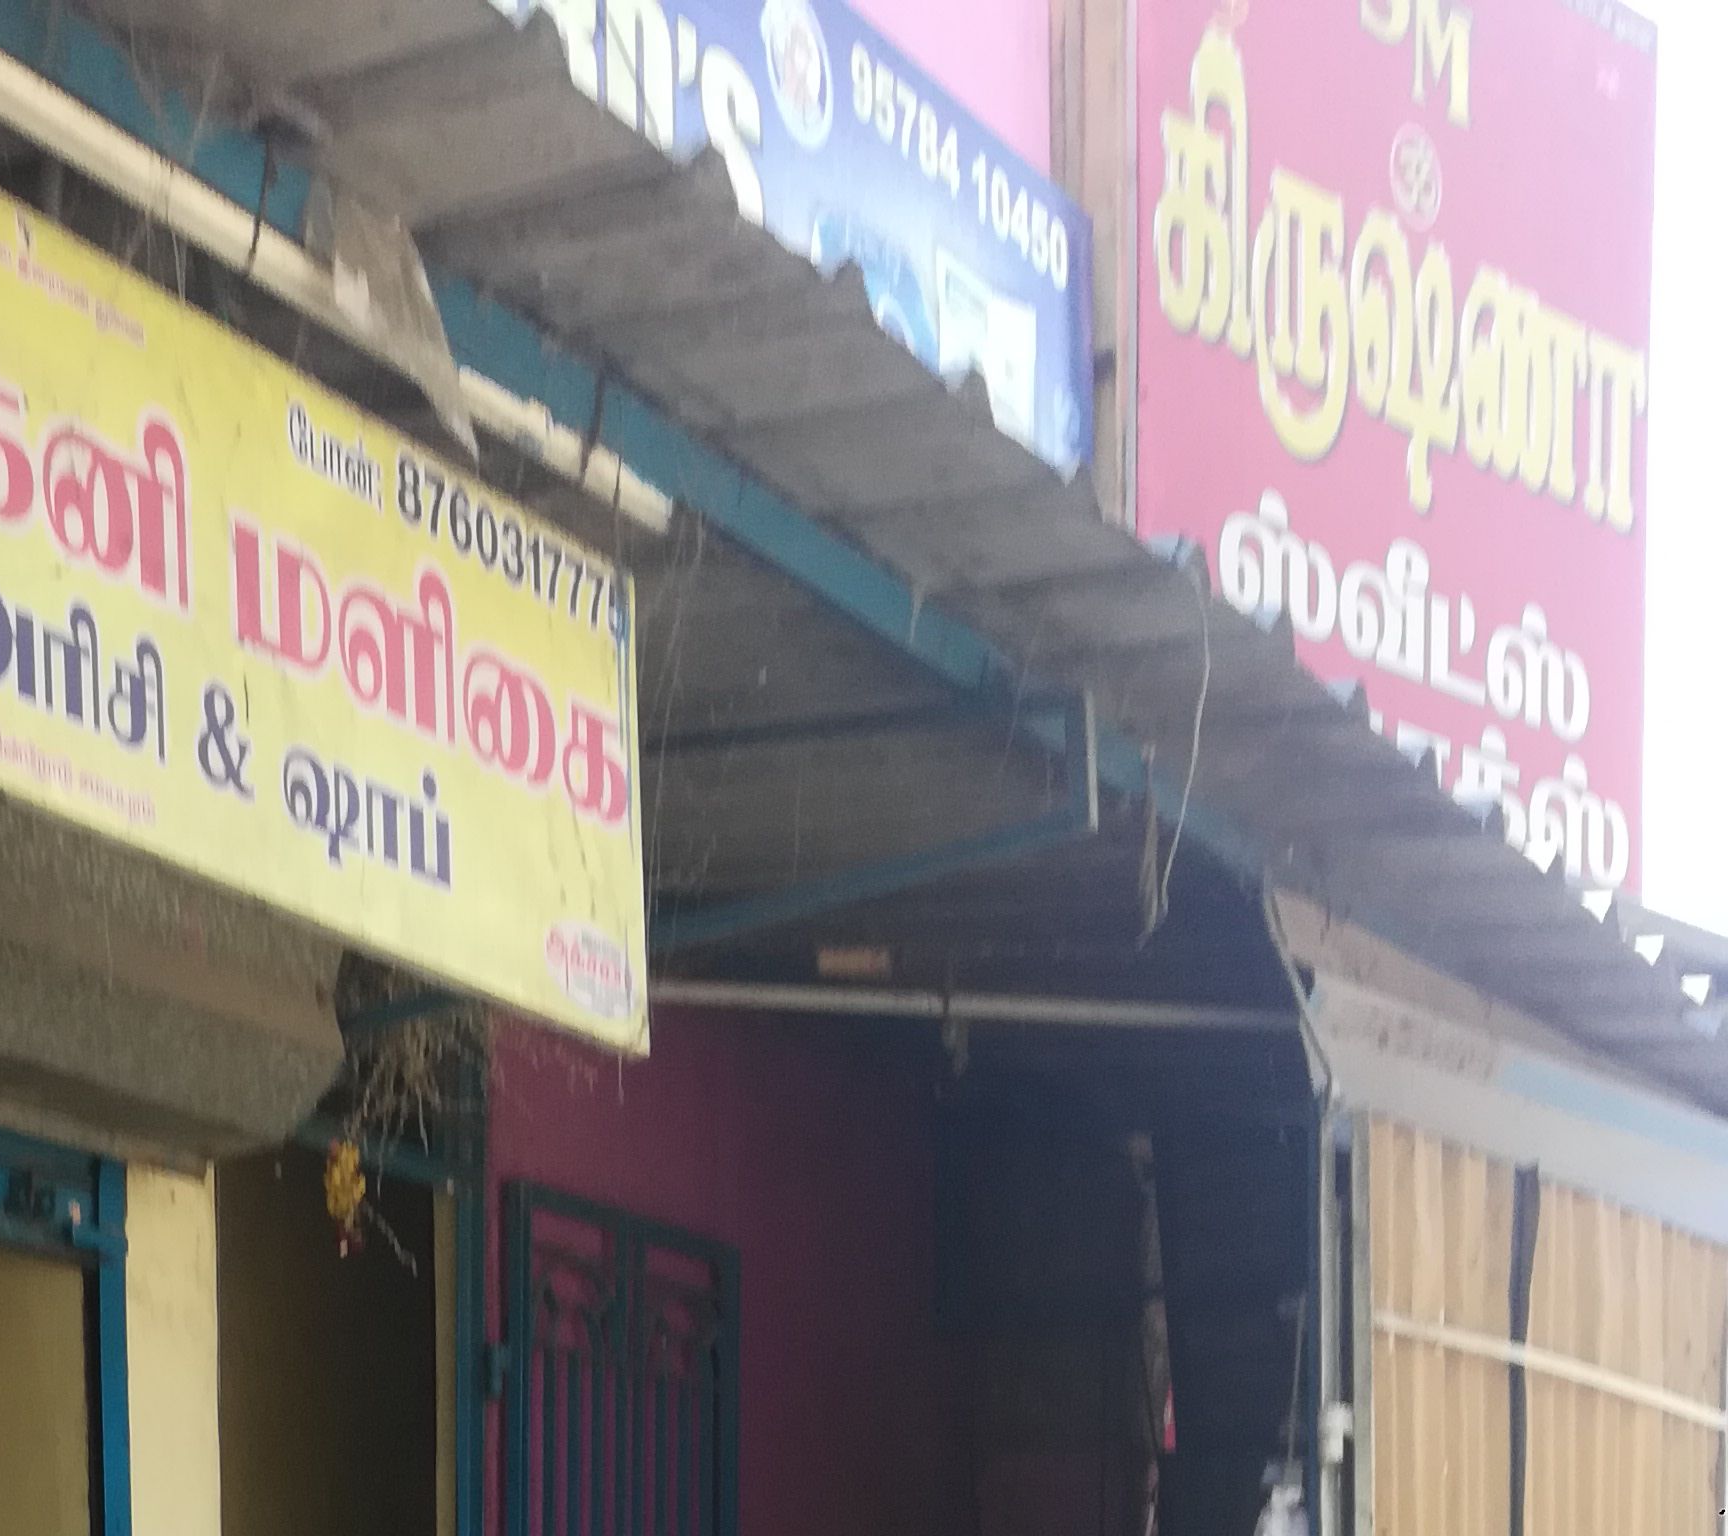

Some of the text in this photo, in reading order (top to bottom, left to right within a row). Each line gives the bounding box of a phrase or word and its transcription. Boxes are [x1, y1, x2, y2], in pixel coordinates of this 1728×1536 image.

[197, 684, 254, 800] &
[282, 748, 453, 890] ஷாப்
[232, 518, 630, 823] மளிகை
